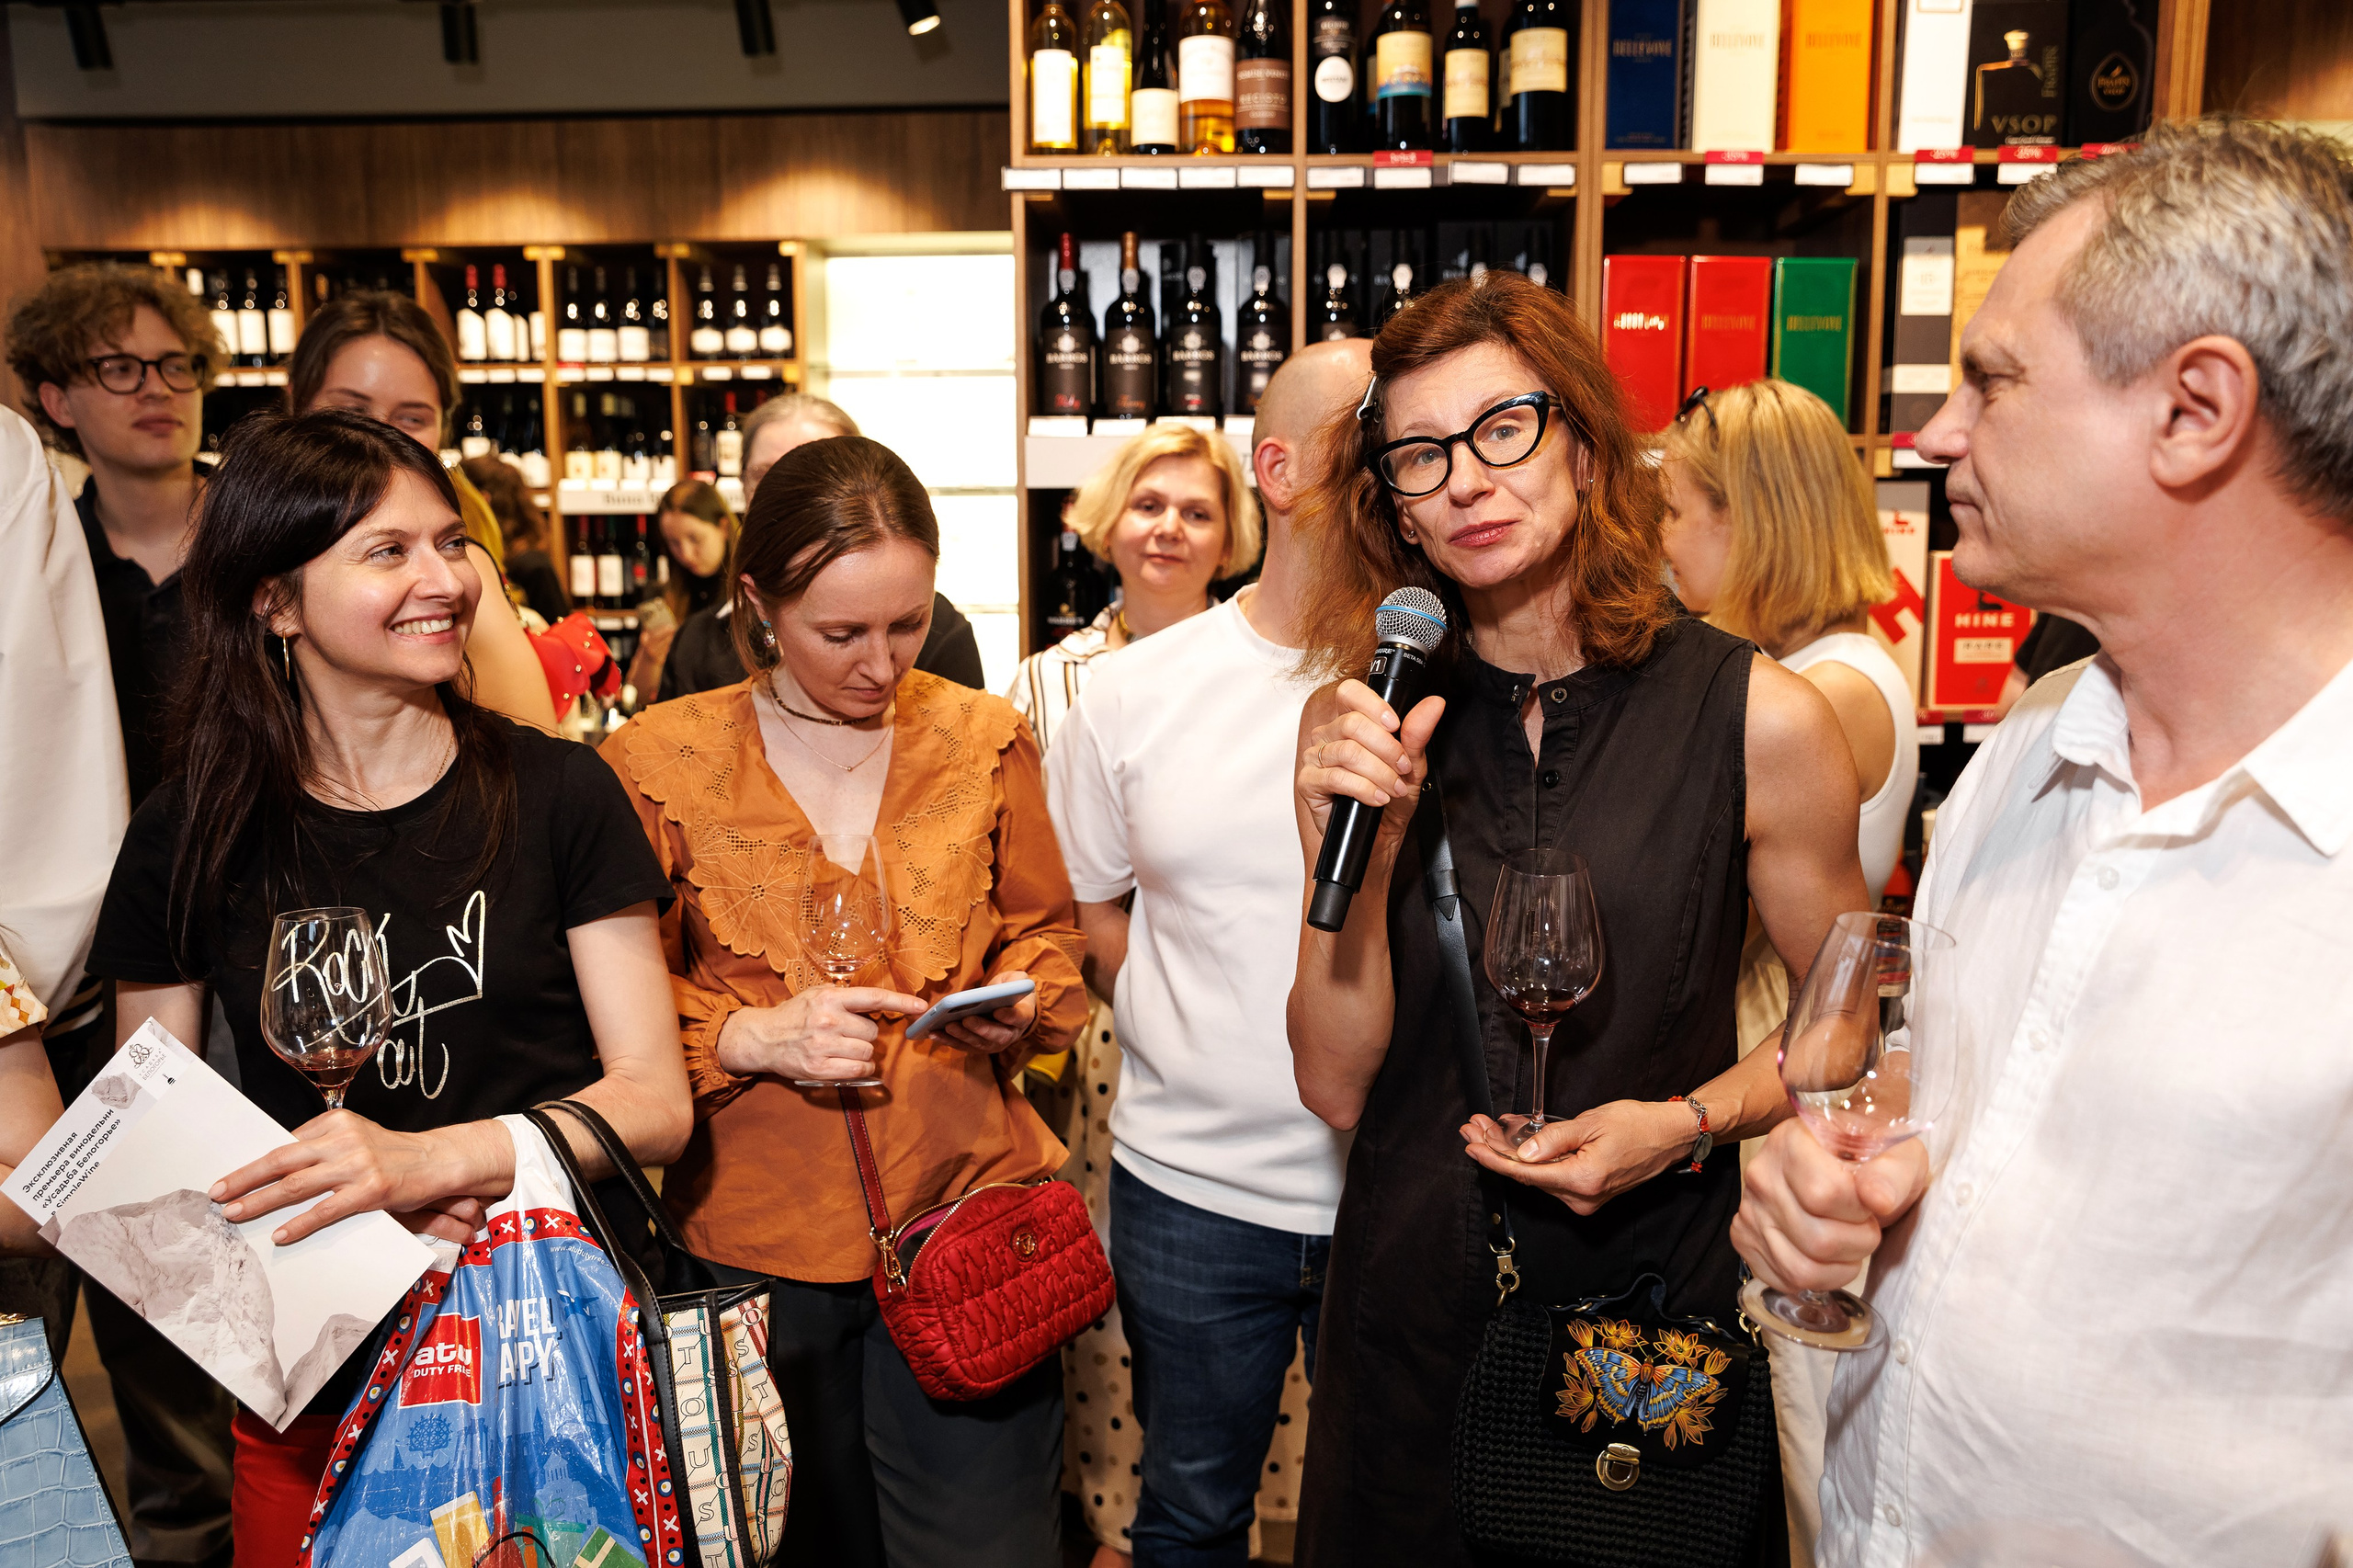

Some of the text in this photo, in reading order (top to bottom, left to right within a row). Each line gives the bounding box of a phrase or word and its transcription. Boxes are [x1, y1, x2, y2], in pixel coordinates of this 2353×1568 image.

[1992, 114, 2057, 134] VSOP
[1954, 612, 2015, 628] HINE
[22, 1131, 78, 1193] Эксклюзивная
[32, 1108, 114, 1201] премьера винодельни
[42, 1119, 121, 1209] «Усадьба Белогорье»
[414, 1366, 445, 1378] DUTY
